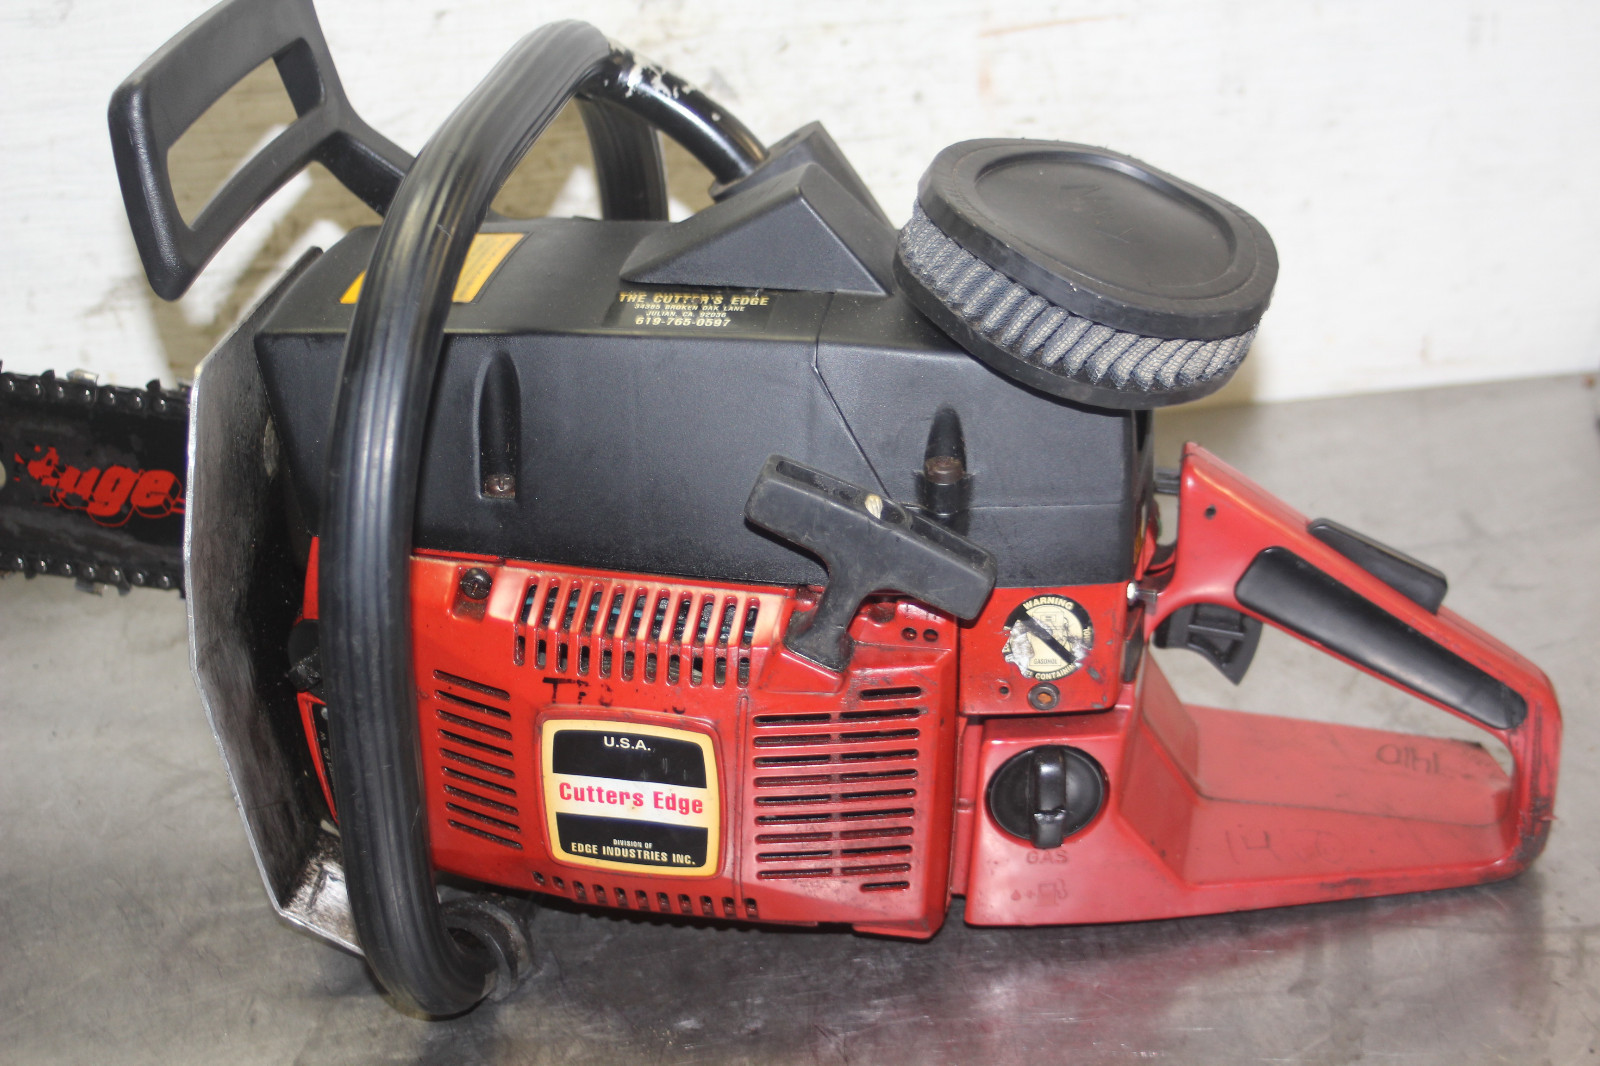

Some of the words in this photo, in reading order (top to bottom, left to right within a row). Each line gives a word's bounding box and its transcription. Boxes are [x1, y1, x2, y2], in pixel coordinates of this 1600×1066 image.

[619, 292, 647, 303] THE
[731, 295, 769, 306] EDGE
[635, 316, 731, 327] 619-765-0597
[1022, 596, 1075, 611] WARNING
[1034, 662, 1077, 681] CONTAININ
[603, 735, 651, 751] U.S.A.
[559, 782, 644, 807] Cutters
[653, 791, 703, 816] Edge
[613, 838, 642, 849] DIVISION
[644, 842, 653, 850] OF
[571, 842, 598, 854] EDGE
[602, 845, 668, 862] INDUSTRIES
[672, 852, 696, 865] INC.
[1026, 849, 1068, 865] GAS
